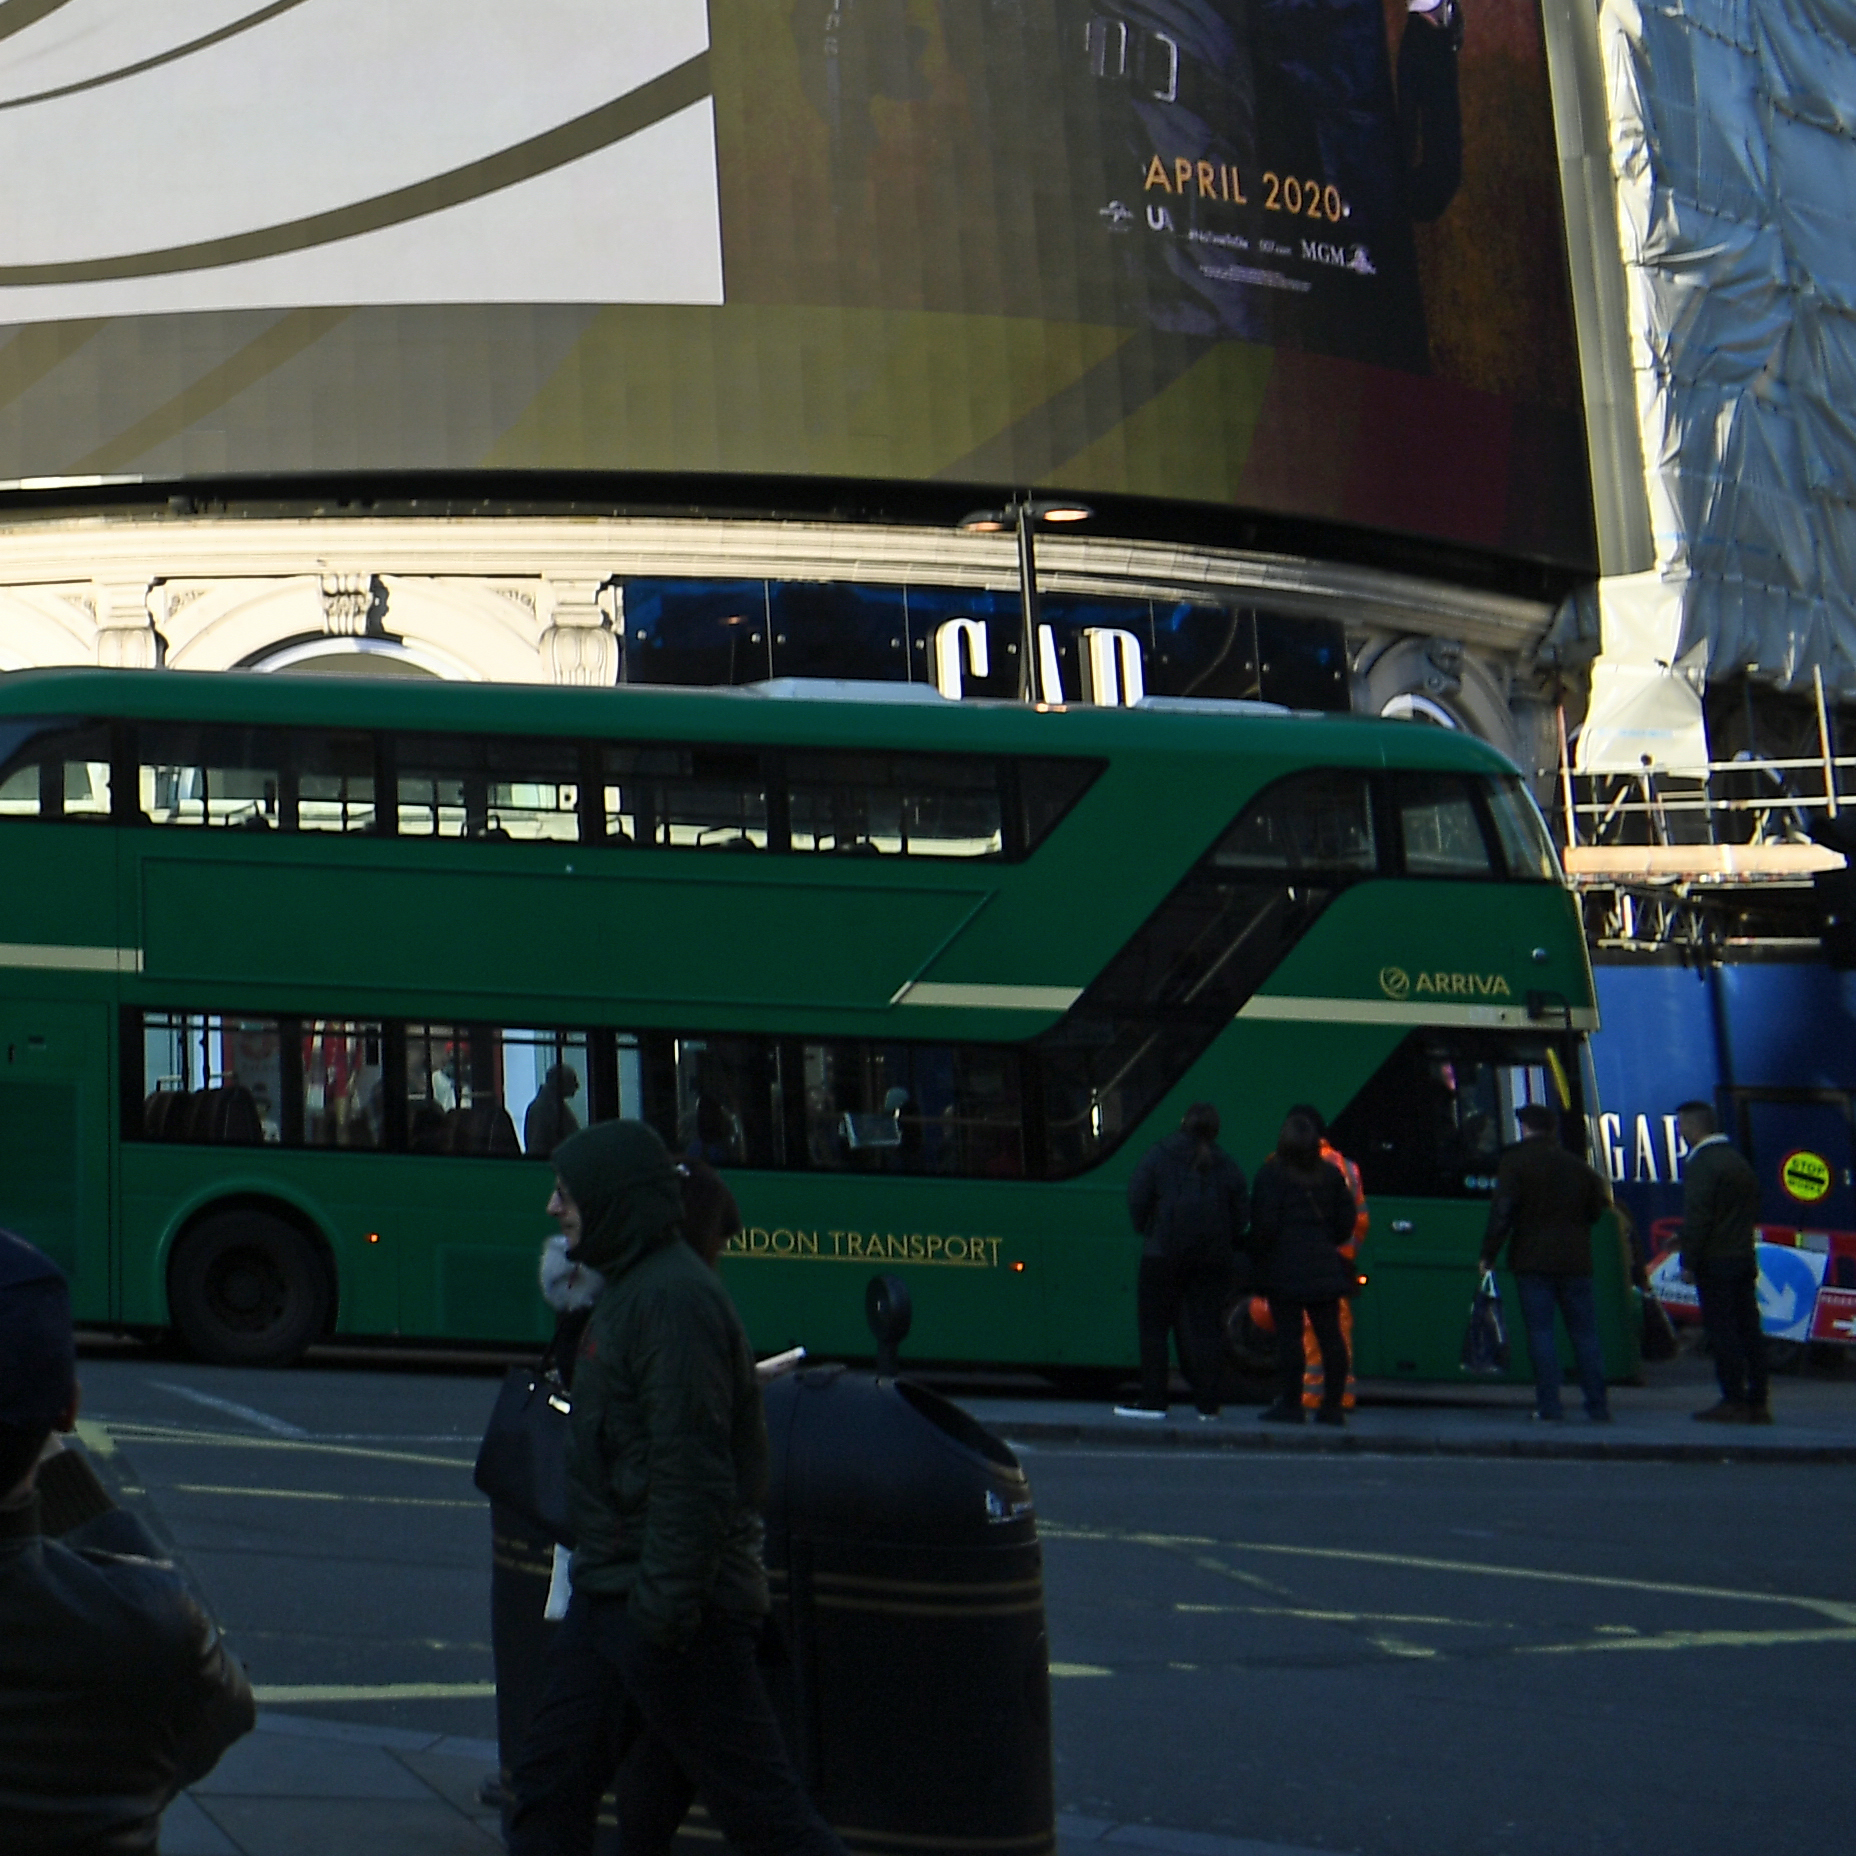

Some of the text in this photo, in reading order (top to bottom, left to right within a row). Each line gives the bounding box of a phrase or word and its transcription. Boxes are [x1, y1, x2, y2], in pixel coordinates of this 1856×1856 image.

[1144, 154, 1342, 223] APRIL 2020
[1301, 239, 1346, 268] MGM
[1416, 972, 1511, 996] ARRIVA
[1599, 1112, 1690, 1183] GAP
[1792, 1159, 1825, 1173] STOP
[725, 1227, 1003, 1266] NDON TRANSPORT
